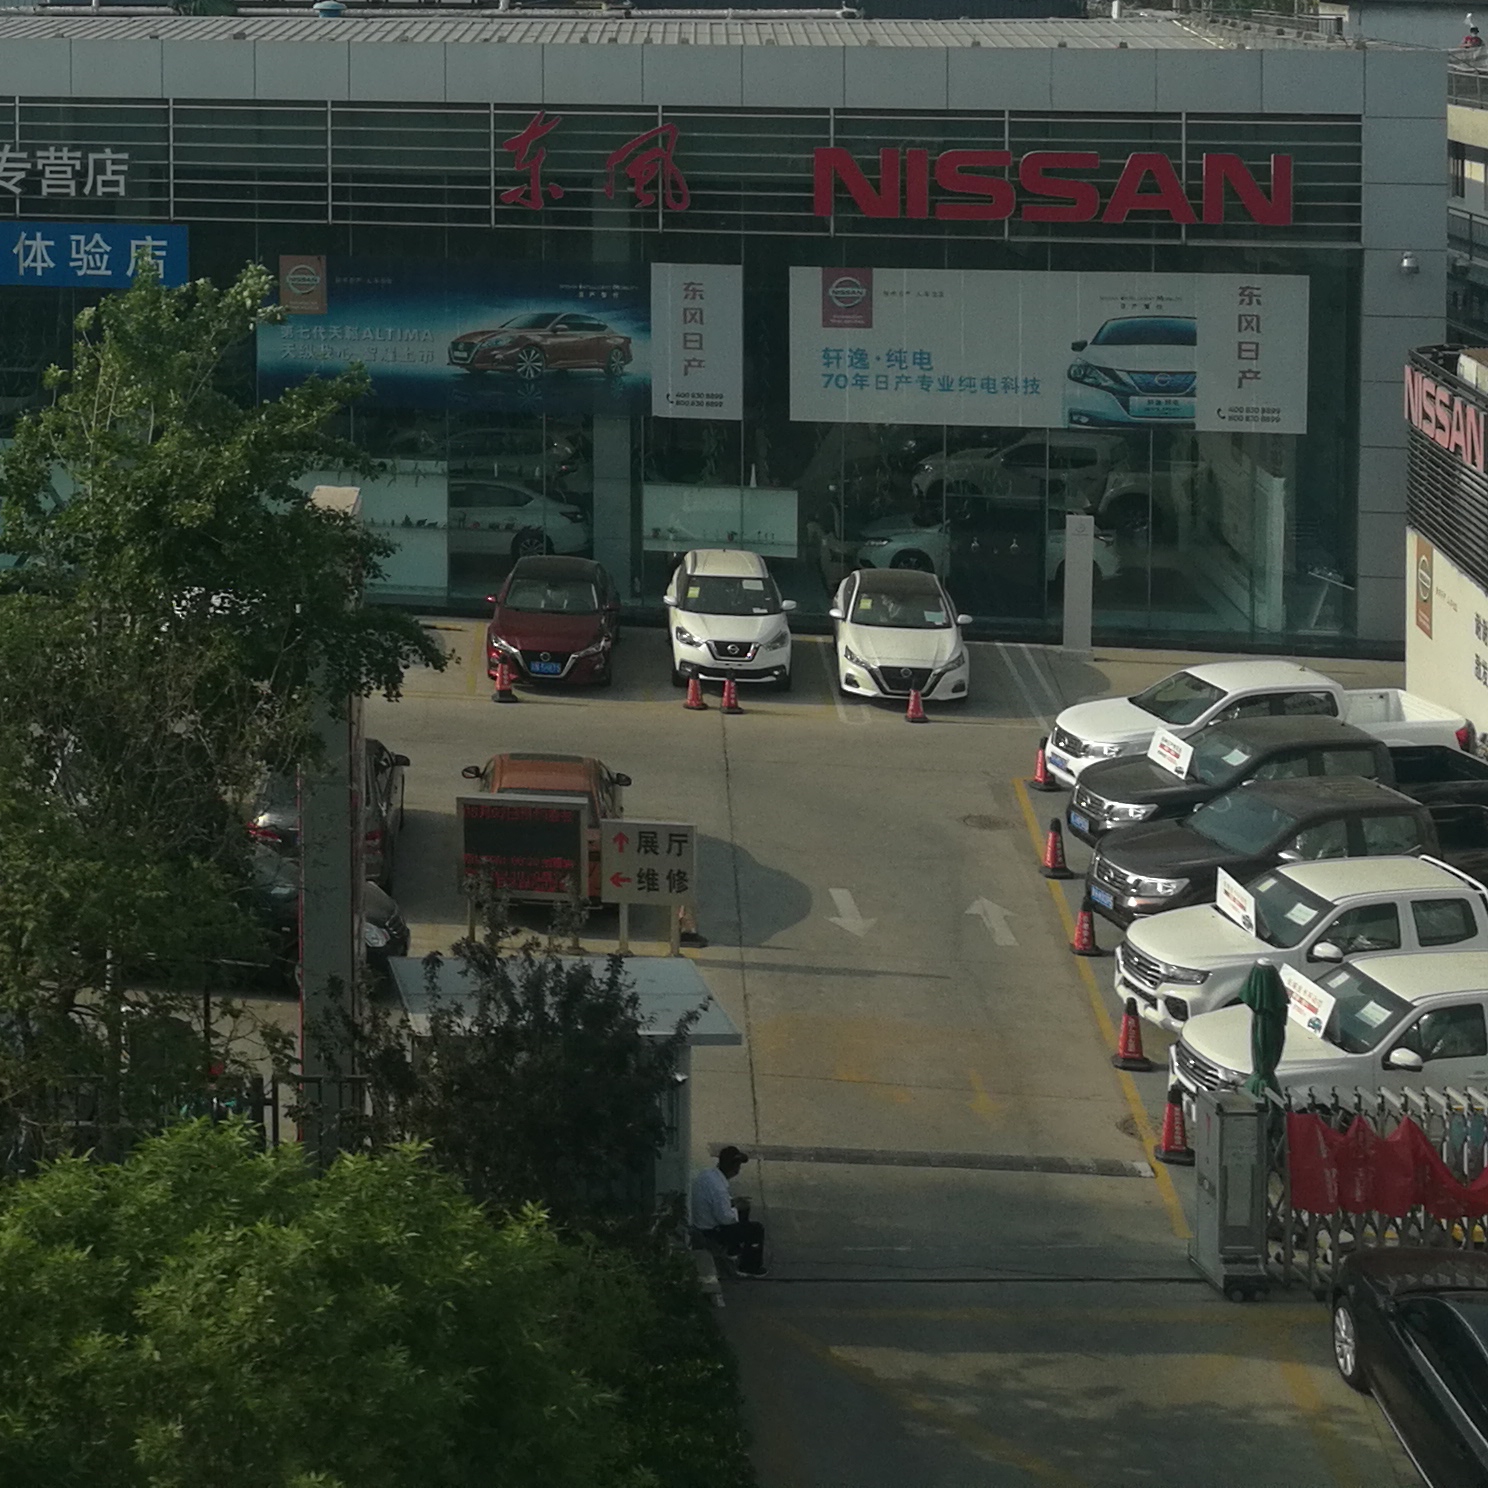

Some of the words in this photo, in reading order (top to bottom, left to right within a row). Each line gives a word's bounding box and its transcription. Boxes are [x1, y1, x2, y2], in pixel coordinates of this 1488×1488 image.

[813, 147, 1294, 227] NISSAN
[12, 230, 169, 280] 体验店
[831, 287, 864, 297] NISSAN
[682, 281, 706, 376] 东风日产
[1237, 285, 1263, 390] 东风日产
[821, 347, 935, 372] 轩逸·纯电
[821, 372, 1042, 396] 70年日产专业纯电科技
[1404, 364, 1485, 475] NISSAN
[637, 831, 689, 857] 展厅
[636, 867, 689, 894] 维修
